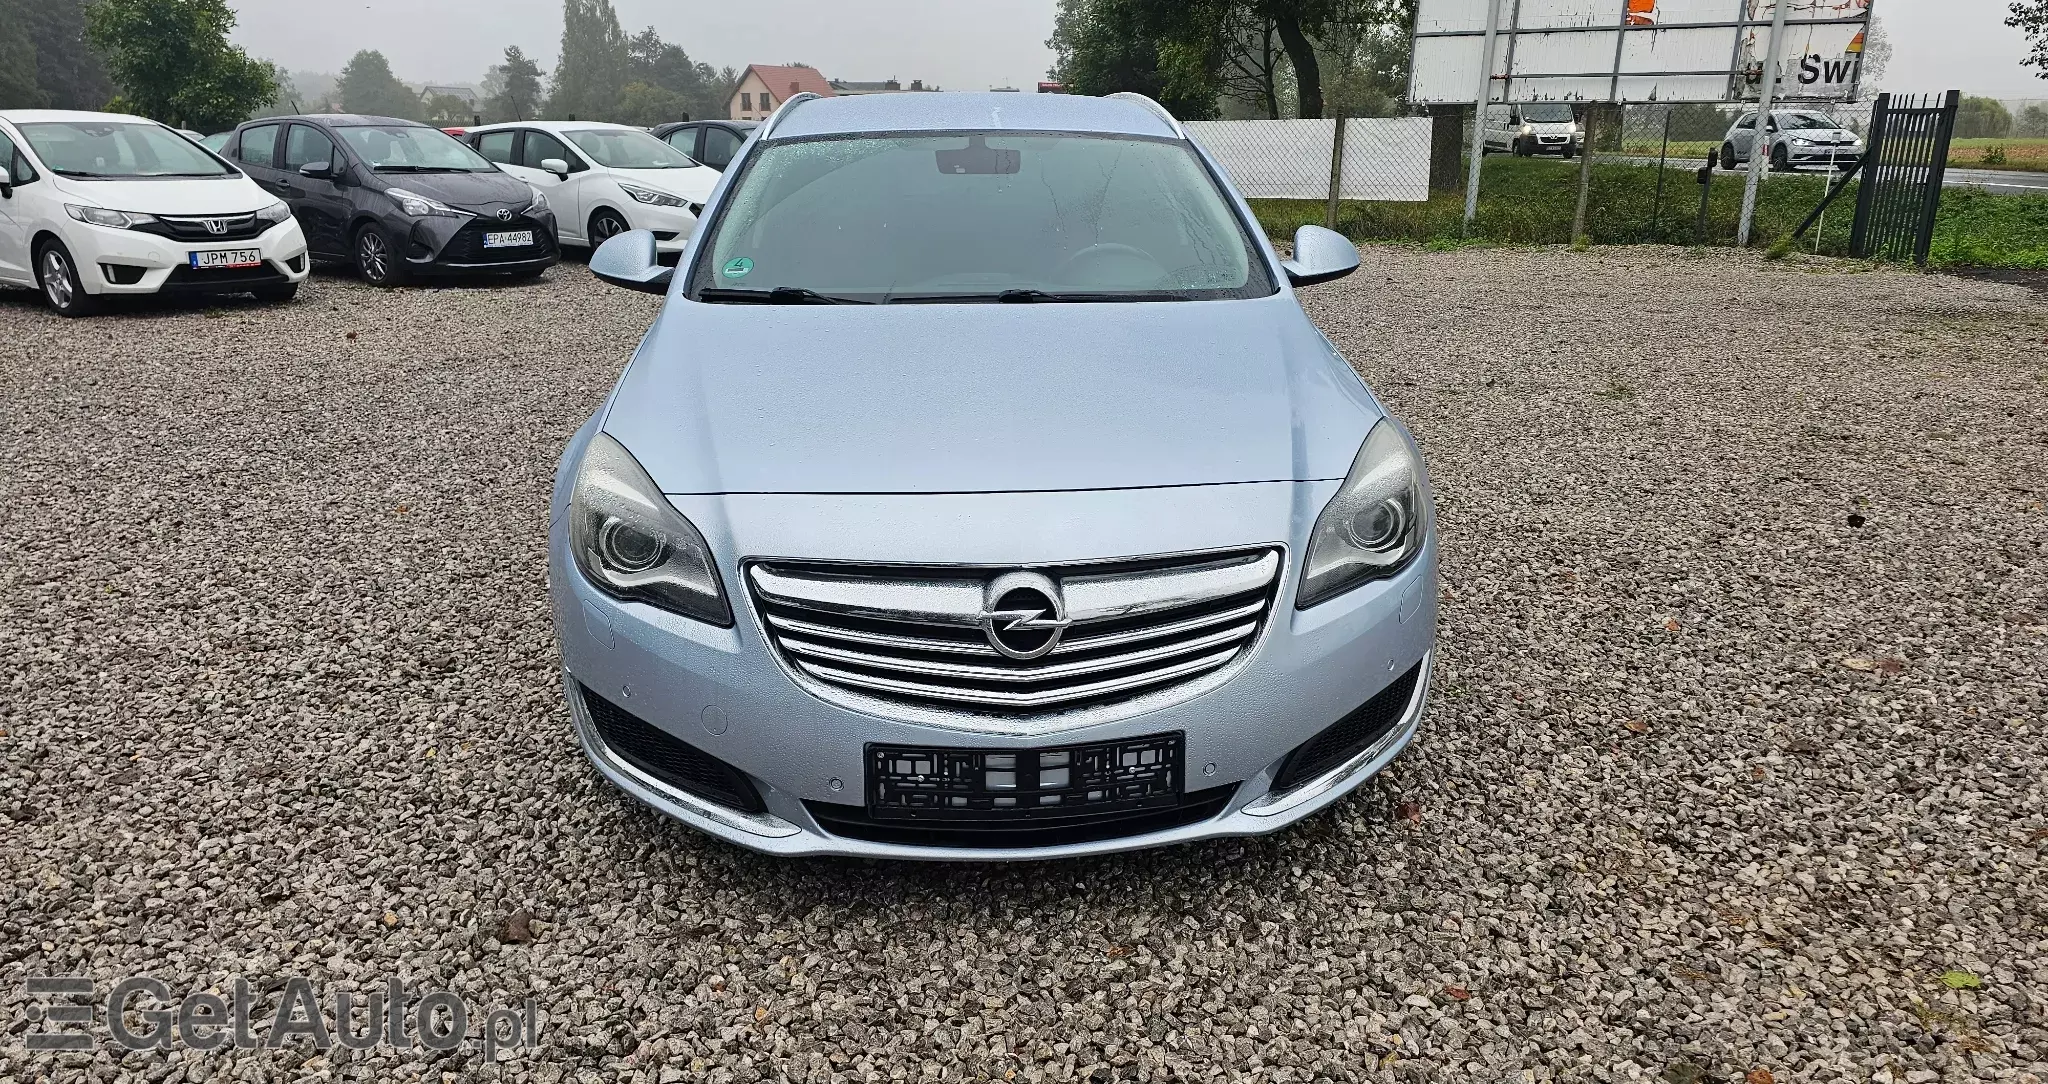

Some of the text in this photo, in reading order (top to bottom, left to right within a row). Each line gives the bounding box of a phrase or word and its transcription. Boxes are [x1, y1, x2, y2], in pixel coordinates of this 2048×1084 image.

[203, 250, 256, 265] JPM 756
[733, 257, 744, 268] 4
